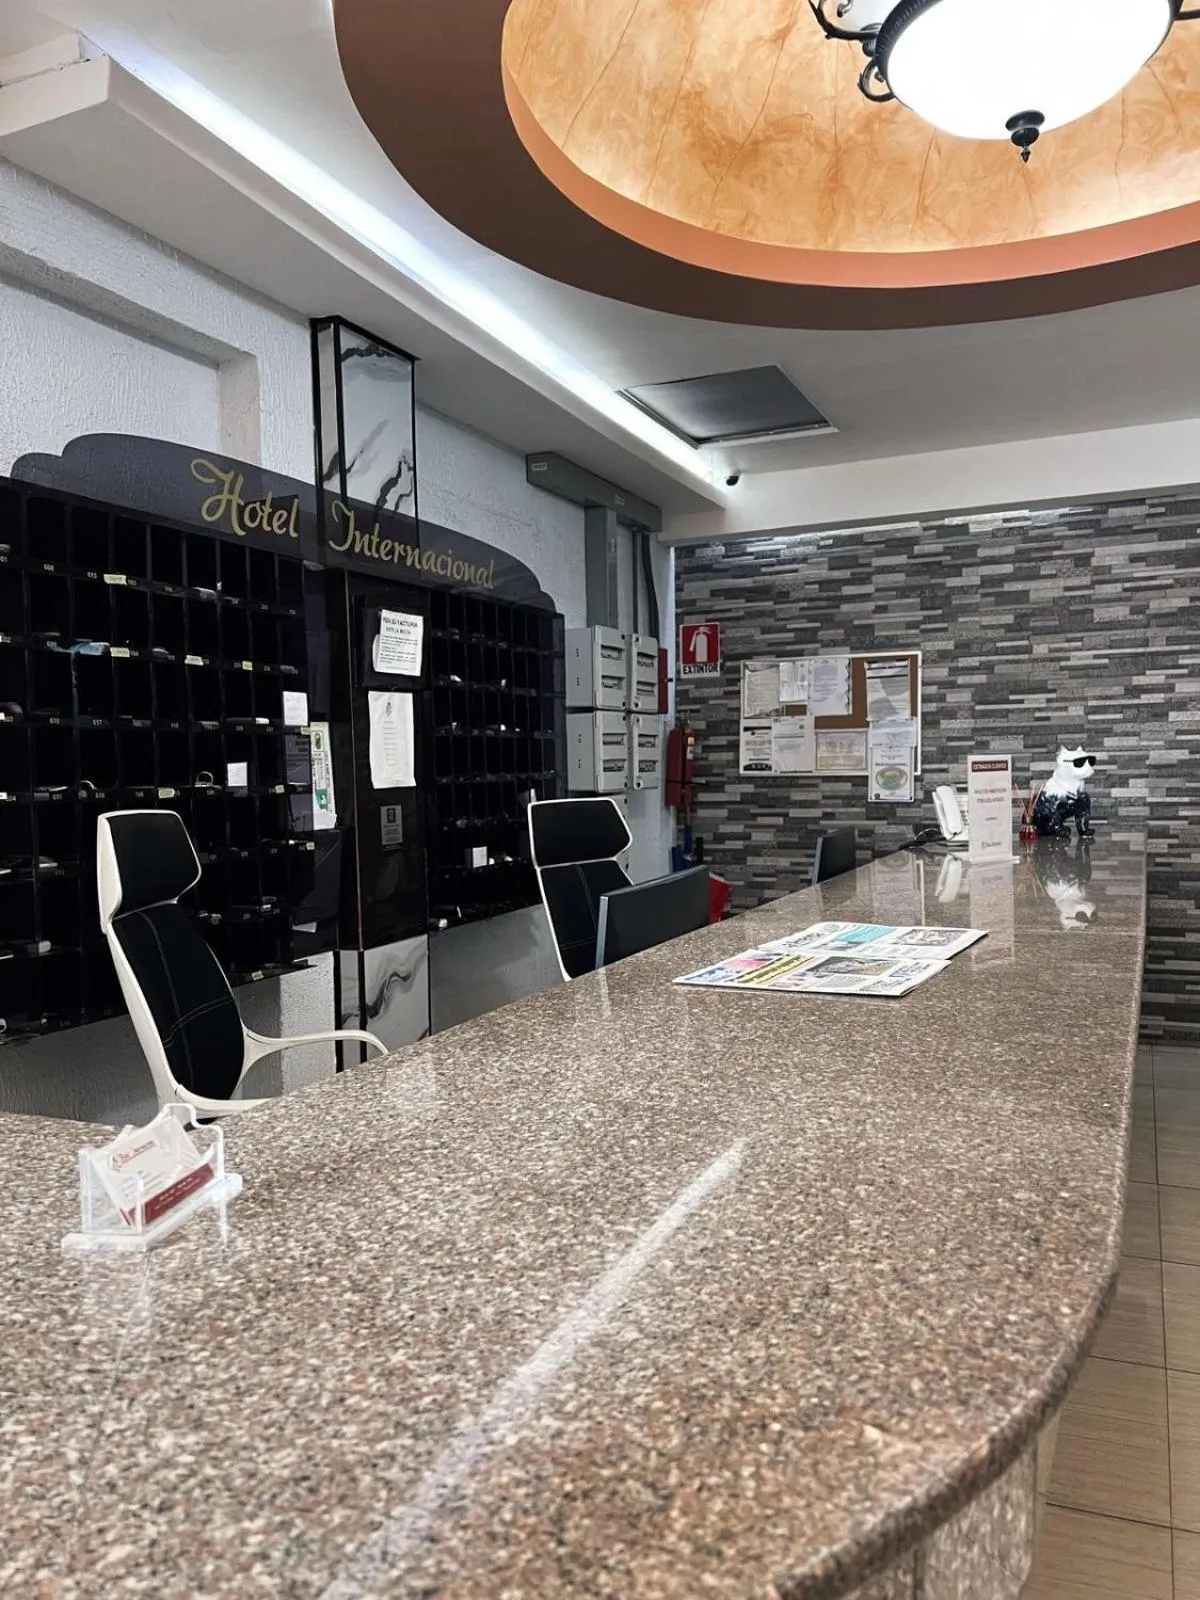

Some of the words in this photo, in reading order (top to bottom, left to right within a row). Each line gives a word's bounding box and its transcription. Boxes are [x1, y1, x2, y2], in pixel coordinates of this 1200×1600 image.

[190, 458, 299, 538] Hotel
[328, 500, 496, 590] Internacional
[683, 664, 718, 675] EXTINTOR
